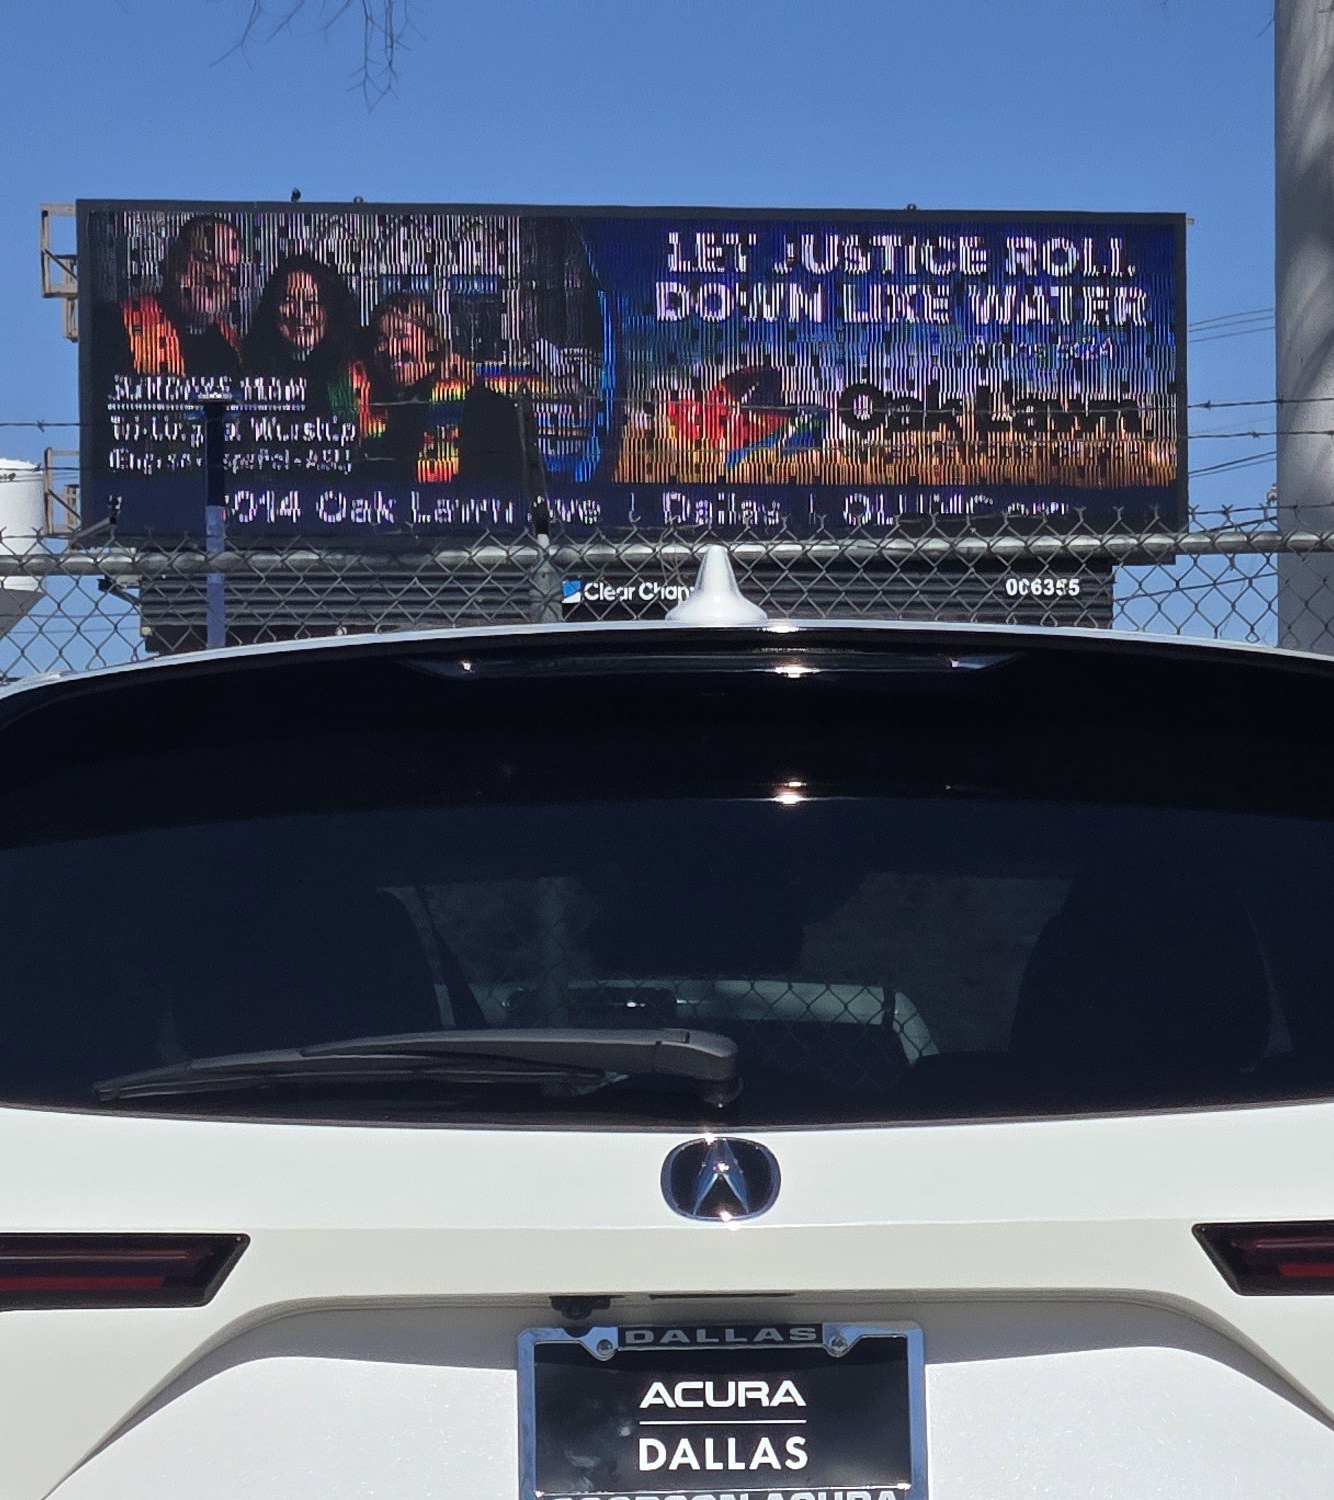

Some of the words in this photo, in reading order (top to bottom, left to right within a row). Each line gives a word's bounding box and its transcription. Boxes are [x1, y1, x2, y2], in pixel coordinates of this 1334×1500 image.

[668, 232, 756, 273] LET
[772, 234, 988, 275] JUSTICE
[656, 282, 823, 323] DOWN
[843, 284, 950, 325] LIKE
[967, 285, 1147, 327] WATER
[843, 379, 964, 435] Oak
[974, 381, 1146, 435] Lawn
[222, 490, 303, 524] 014
[315, 490, 397, 524] Oak
[410, 490, 515, 524] Lawn
[584, 582, 635, 601] Clear
[1005, 578, 1080, 596] 006355
[624, 1327, 818, 1344] DALLAS
[639, 1380, 807, 1409] ACURA
[638, 1436, 808, 1471] DALLAS
